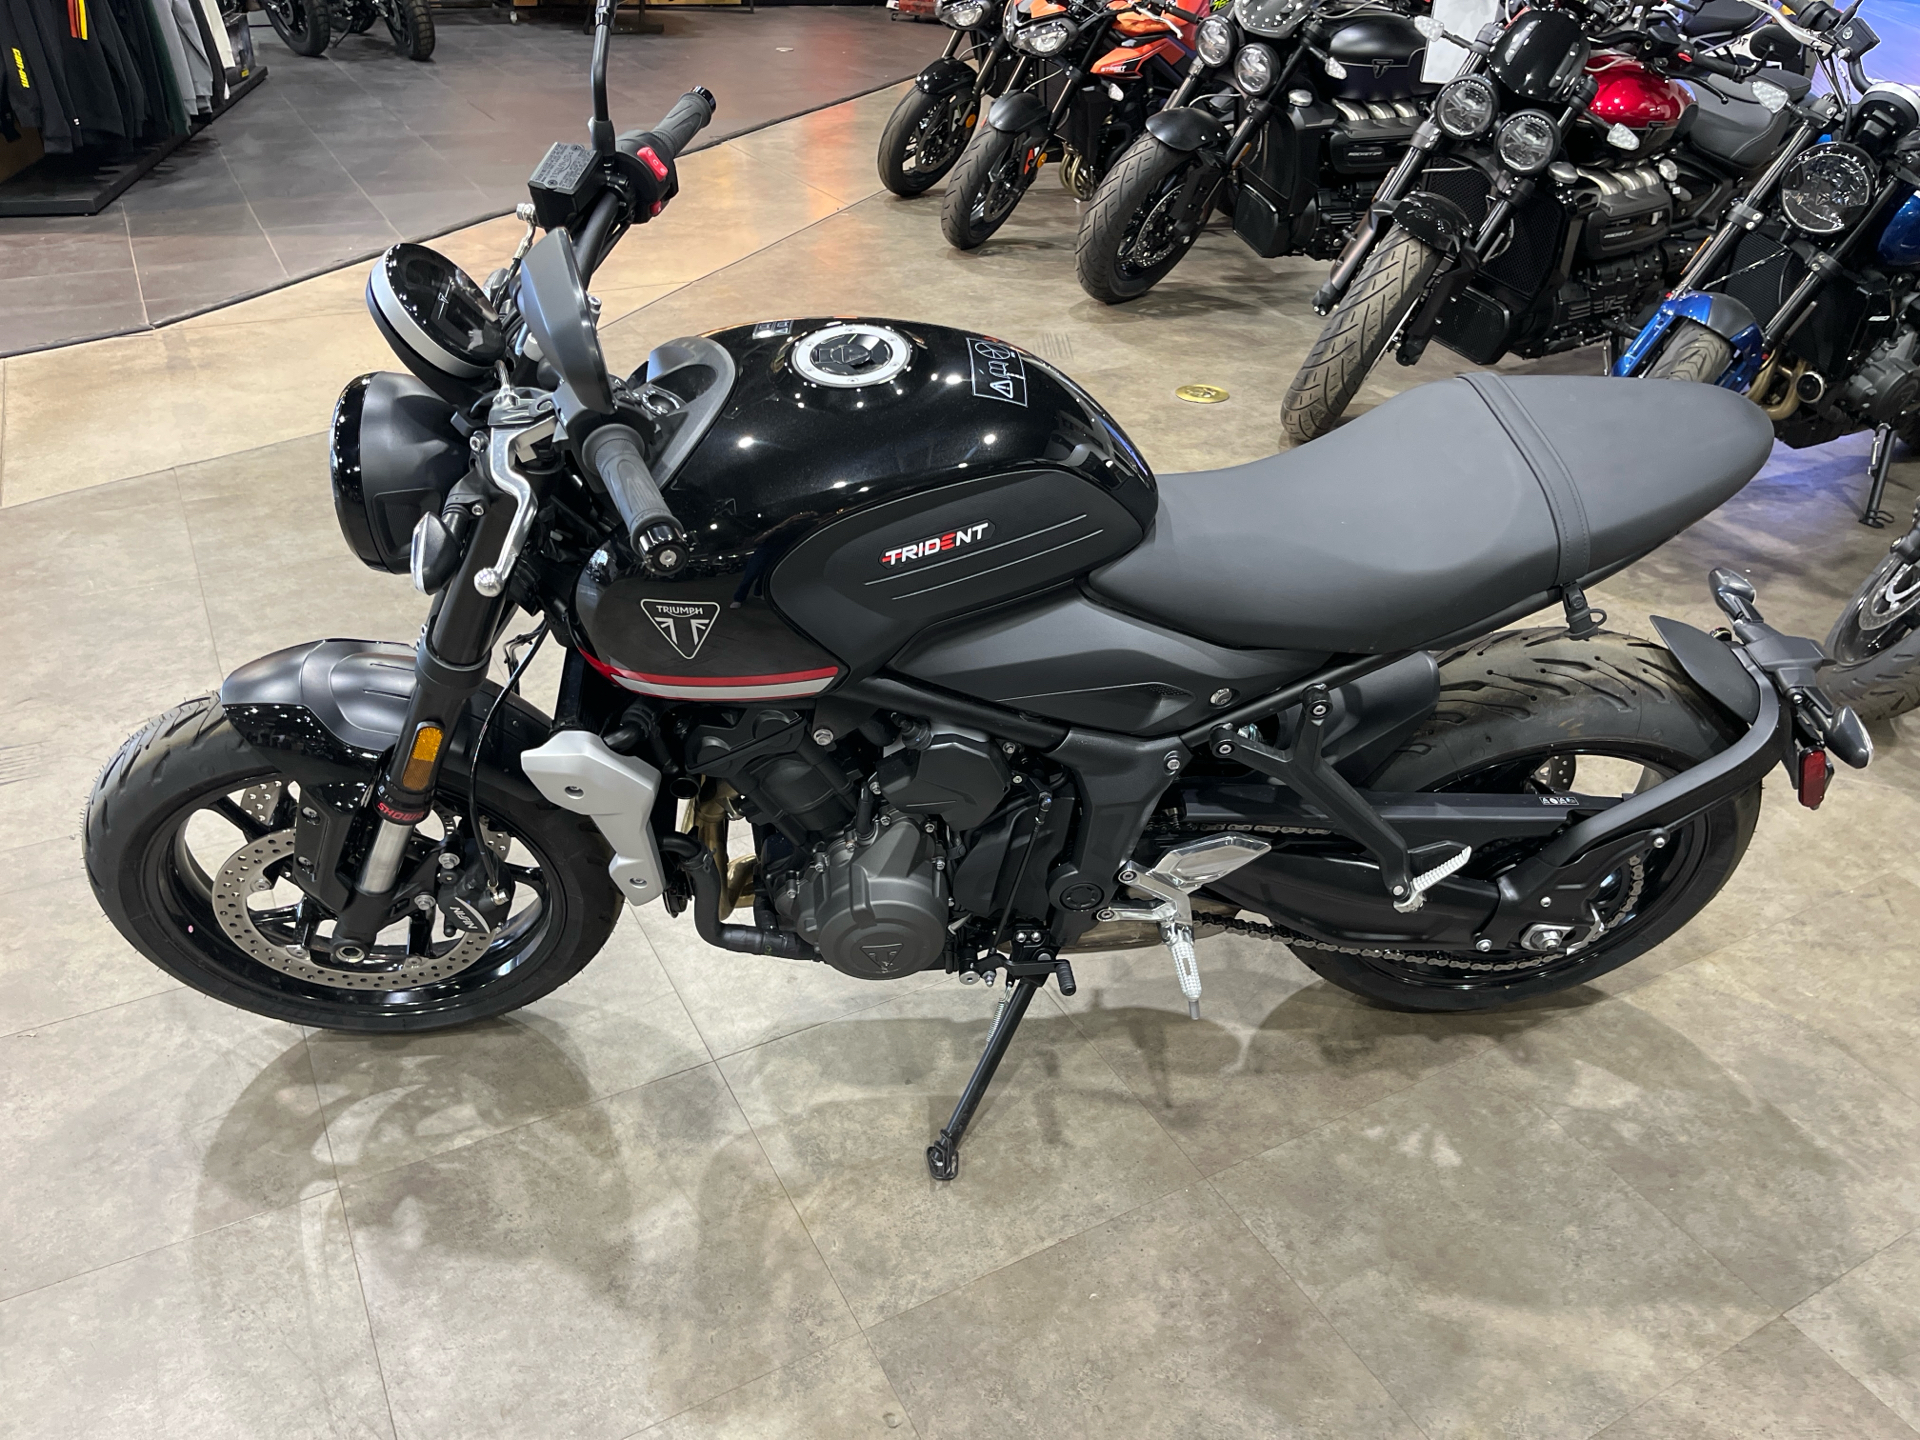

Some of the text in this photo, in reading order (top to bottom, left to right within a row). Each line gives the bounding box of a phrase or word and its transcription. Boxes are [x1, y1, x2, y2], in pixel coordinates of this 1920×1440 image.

[881, 522, 989, 565] TRIDENT
[656, 605, 704, 616] TRIUMPH
[377, 801, 425, 821] SHOWA
